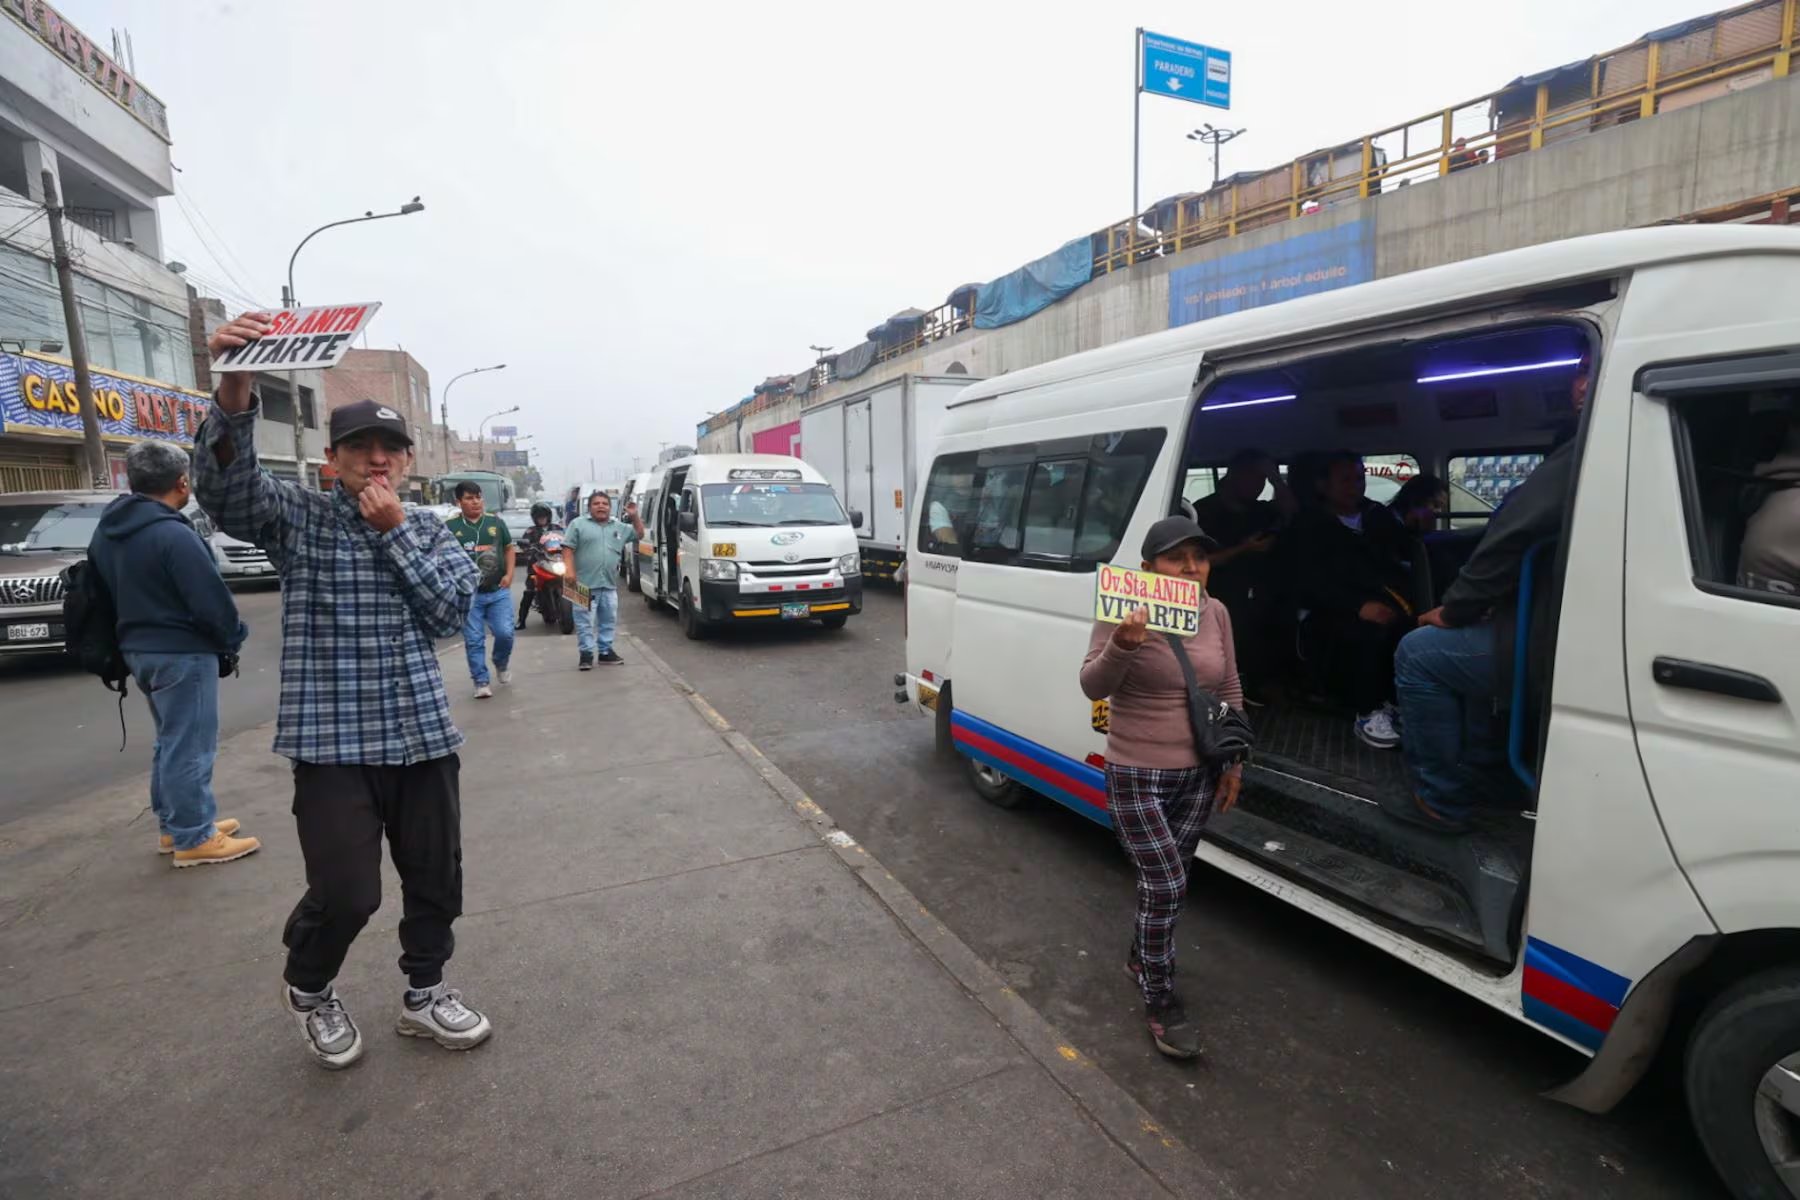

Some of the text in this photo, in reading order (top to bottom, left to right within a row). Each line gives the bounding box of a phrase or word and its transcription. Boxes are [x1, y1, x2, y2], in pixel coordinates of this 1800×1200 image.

[1154, 60, 1195, 79] PARADERO
[296, 306, 368, 333] ANITA
[24, 374, 125, 421] CASNO
[133, 391, 179, 433] REY
